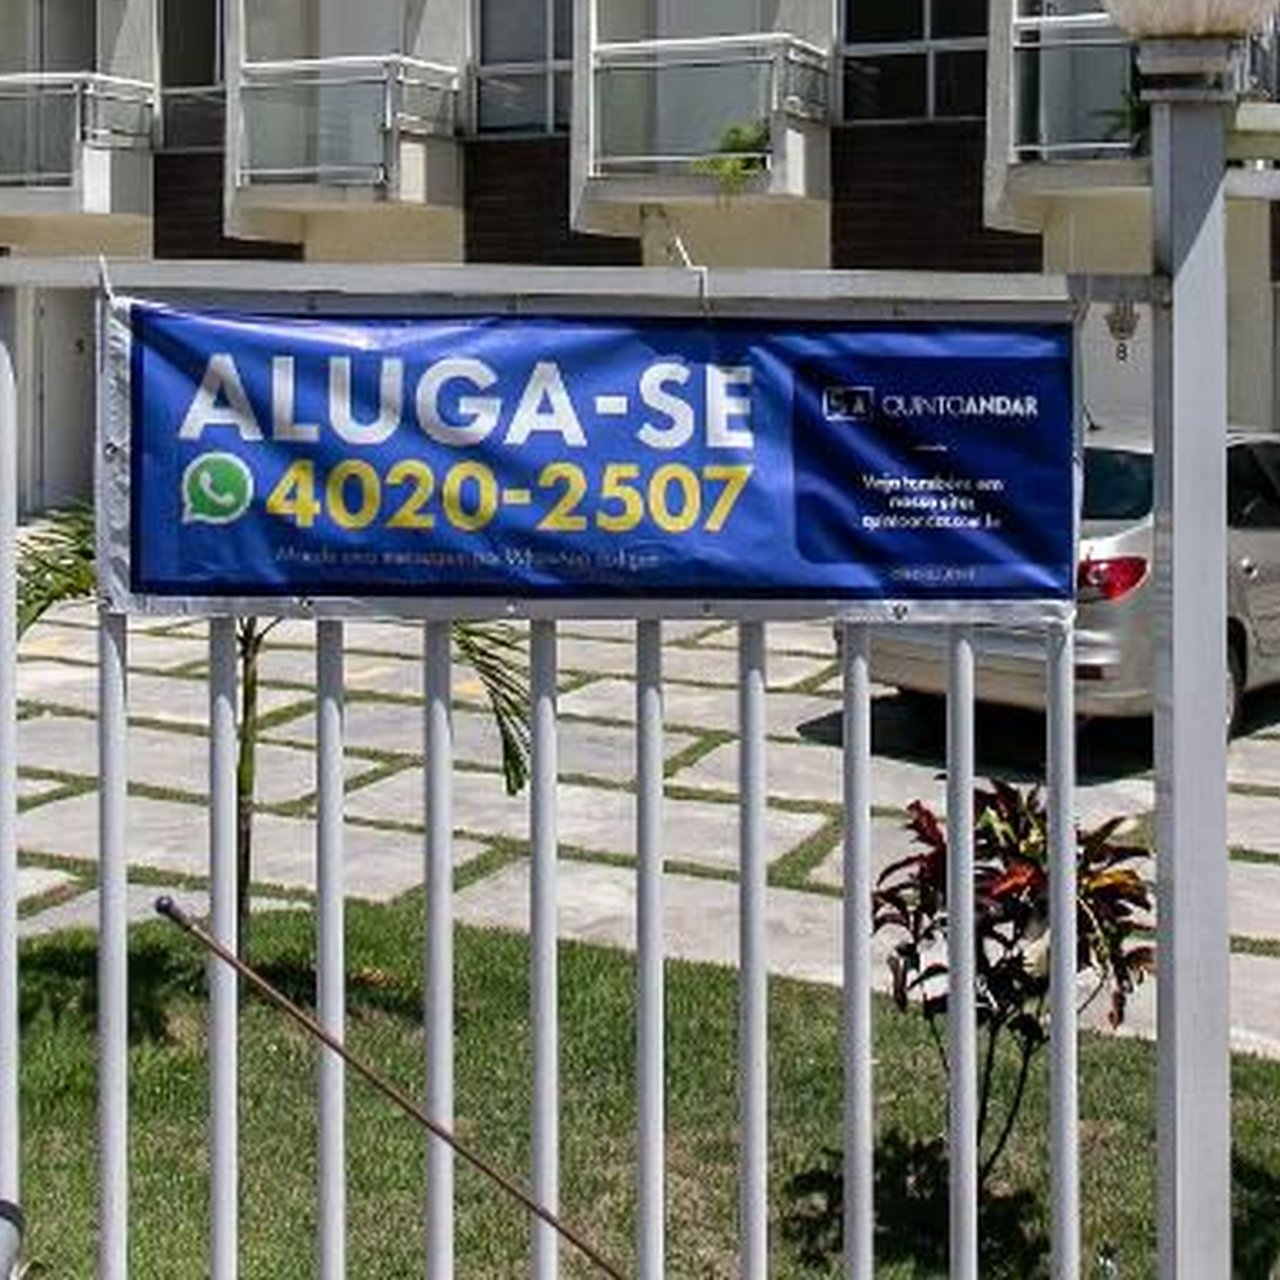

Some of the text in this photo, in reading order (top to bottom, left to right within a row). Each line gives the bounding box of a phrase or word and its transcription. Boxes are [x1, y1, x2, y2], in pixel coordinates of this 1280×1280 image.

[1116, 342, 1128, 361] 8
[179, 353, 755, 448] ALUGA-SE
[265, 459, 754, 532] 4020-2507
